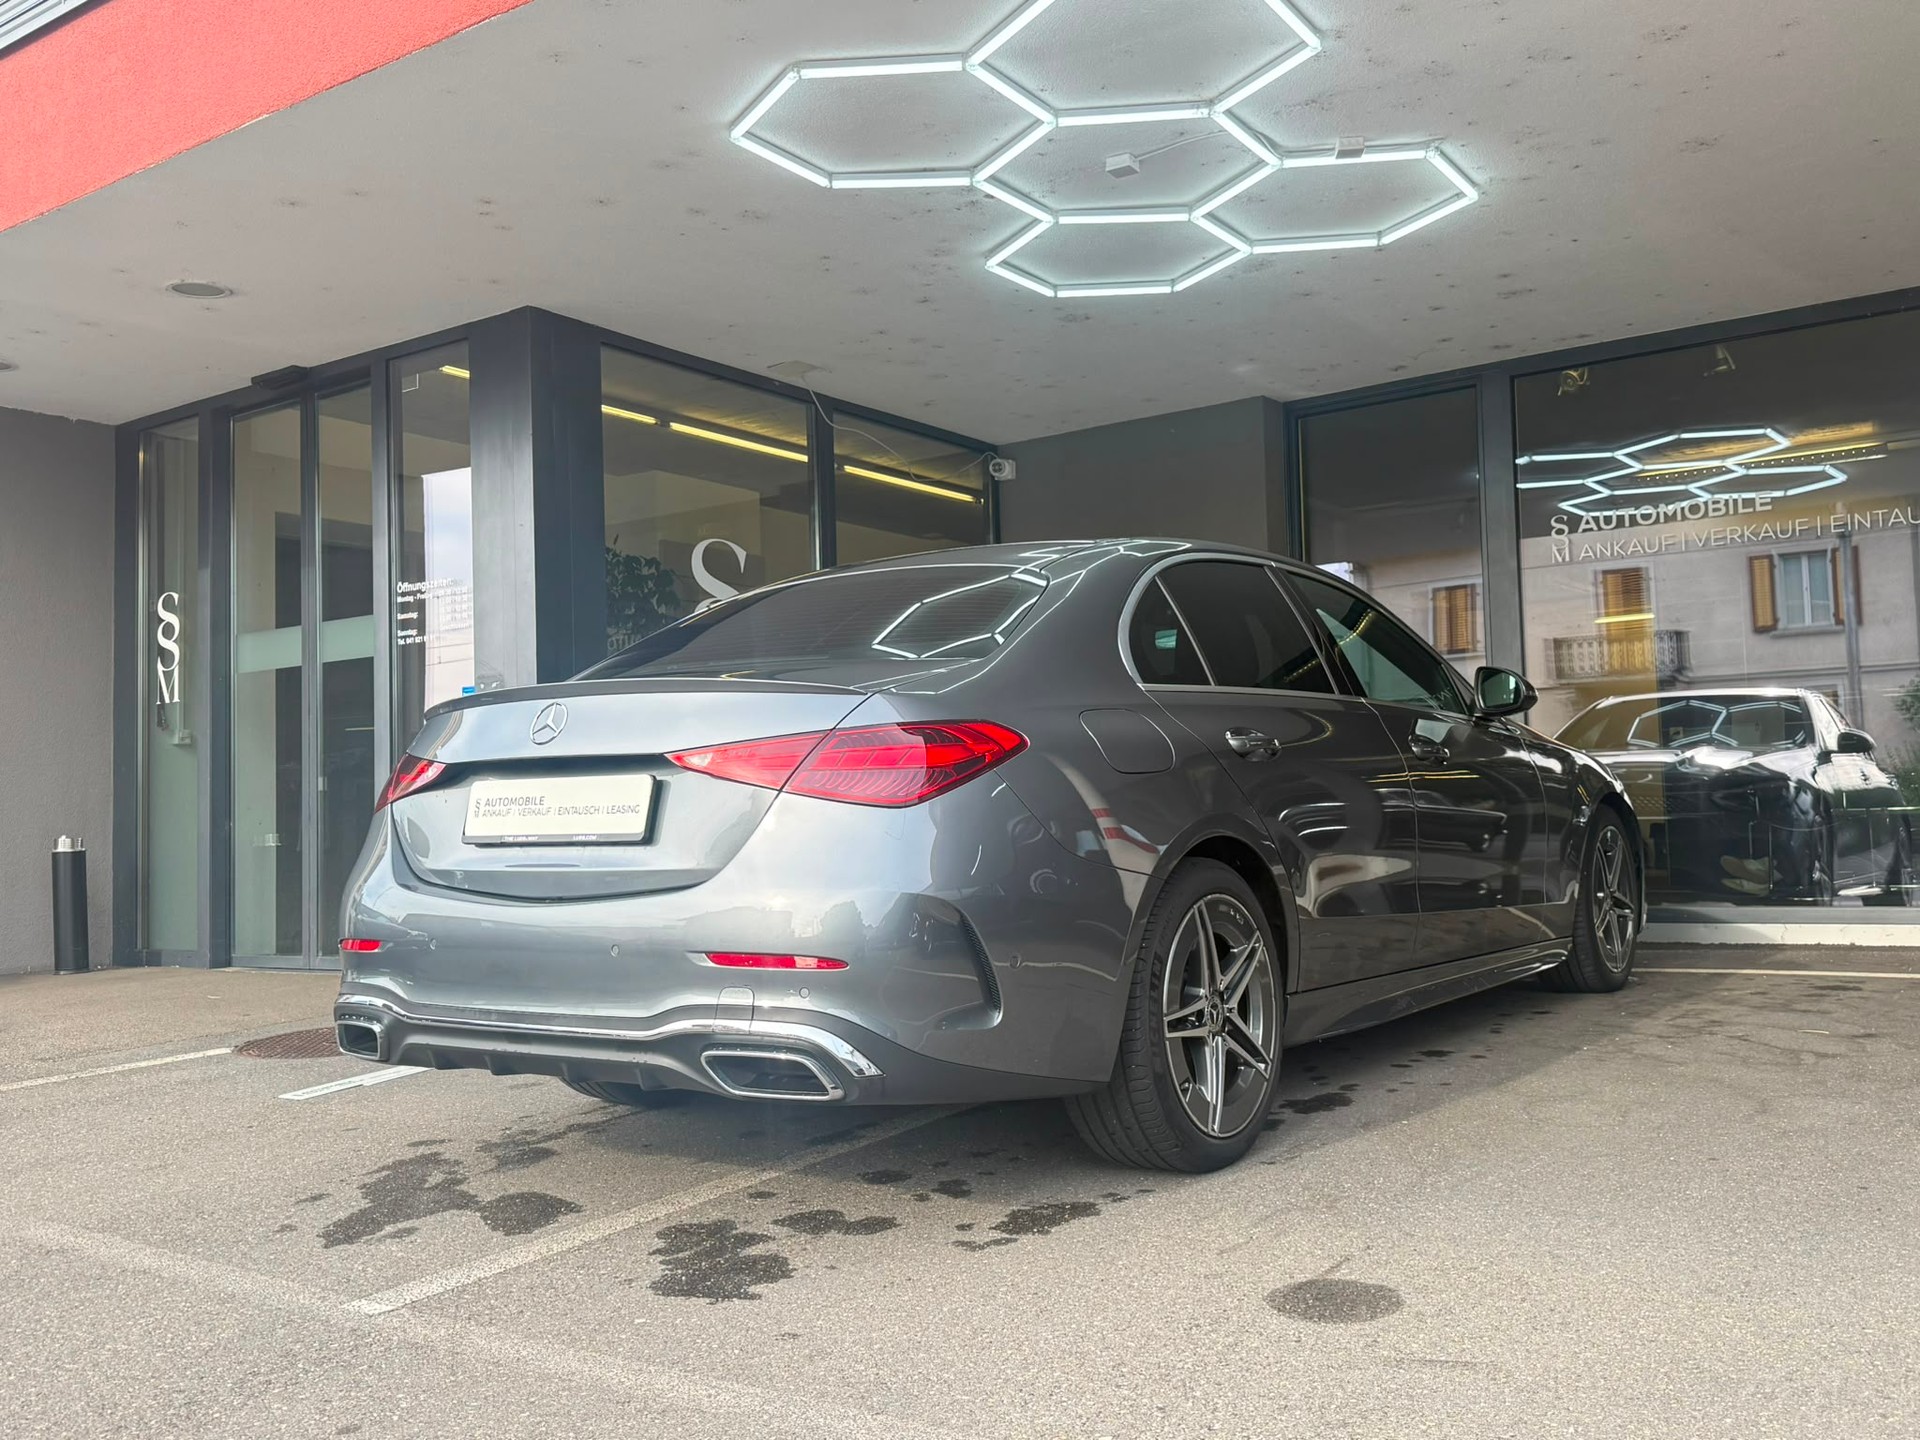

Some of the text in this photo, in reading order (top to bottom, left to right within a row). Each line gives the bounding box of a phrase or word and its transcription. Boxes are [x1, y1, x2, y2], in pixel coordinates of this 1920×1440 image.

[1577, 493, 1773, 534] AUTOMOBILE
[1578, 533, 1676, 561] ANKAUF
[1692, 518, 1809, 548] VERKAUF
[1830, 506, 1920, 534] EINTAU
[482, 807, 512, 818] ANKAUF
[518, 806, 552, 817] VERKAUF
[557, 805, 600, 816] EINTAUSCH
[606, 804, 641, 815] LEASING
[484, 795, 546, 808] AUTOMOBILE
